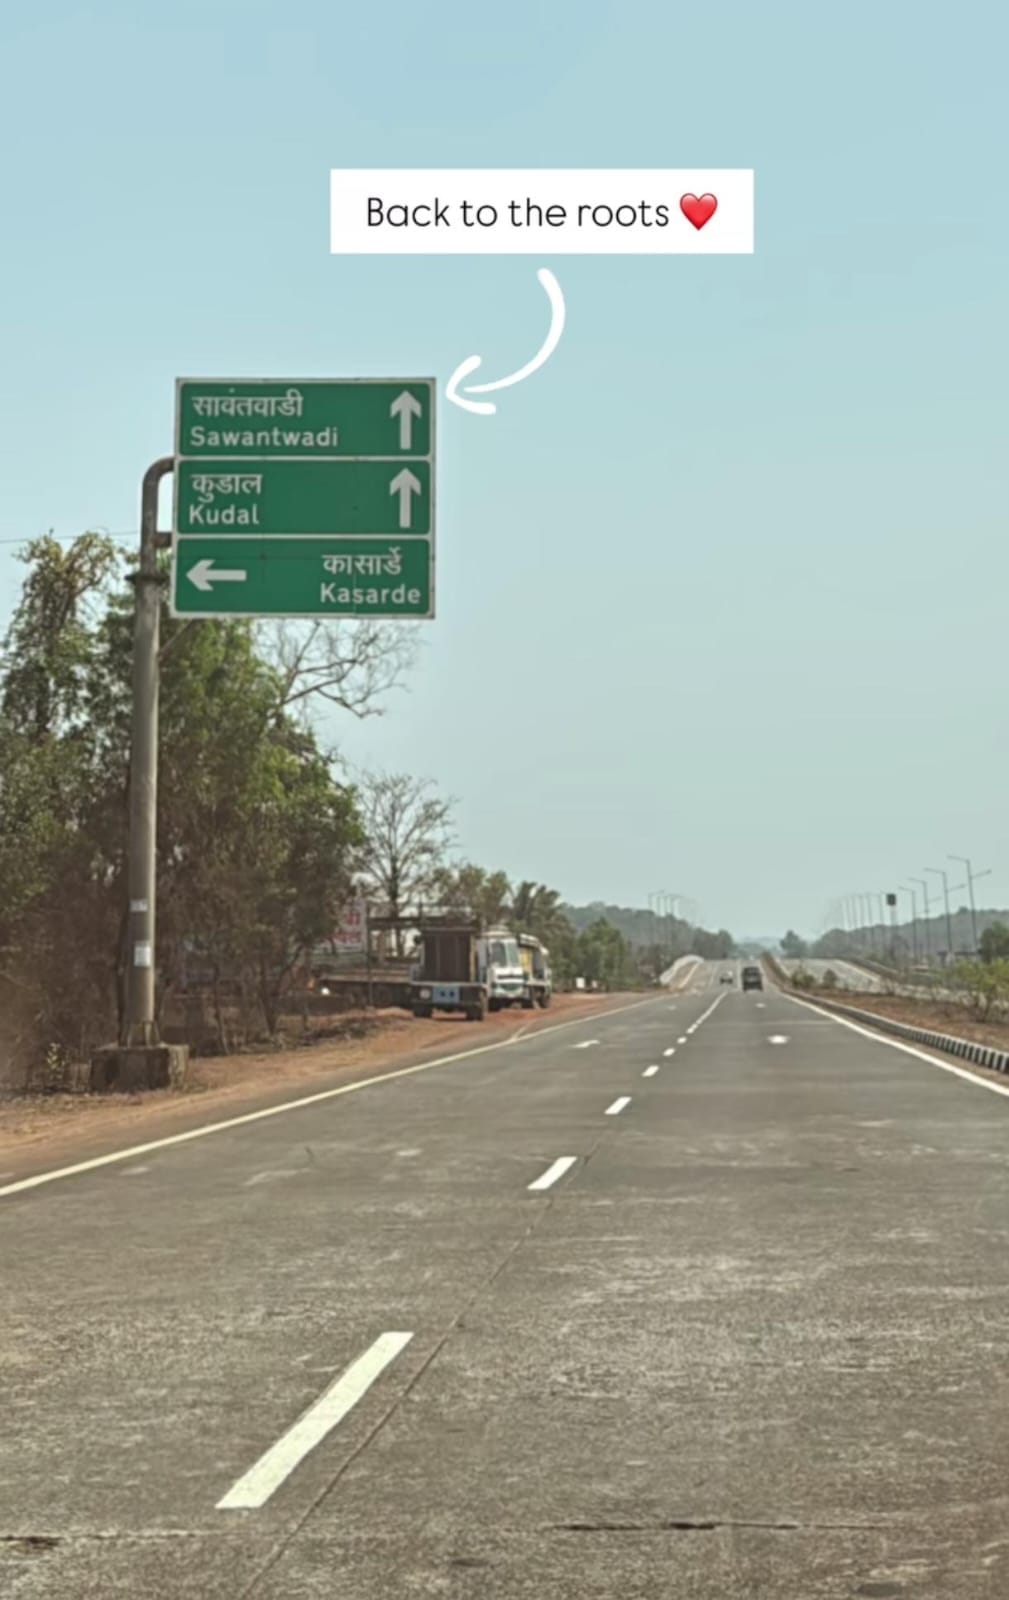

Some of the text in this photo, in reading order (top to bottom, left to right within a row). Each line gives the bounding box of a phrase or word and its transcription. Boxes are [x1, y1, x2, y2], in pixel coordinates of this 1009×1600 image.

[192, 388, 304, 417] सावंतवाडी
[190, 426, 338, 447] Sawantwadi
[191, 474, 263, 503] कुडाल
[189, 504, 260, 525] Kudal
[321, 547, 403, 576] कासार्डे
[320, 583, 421, 604] Kasarde
